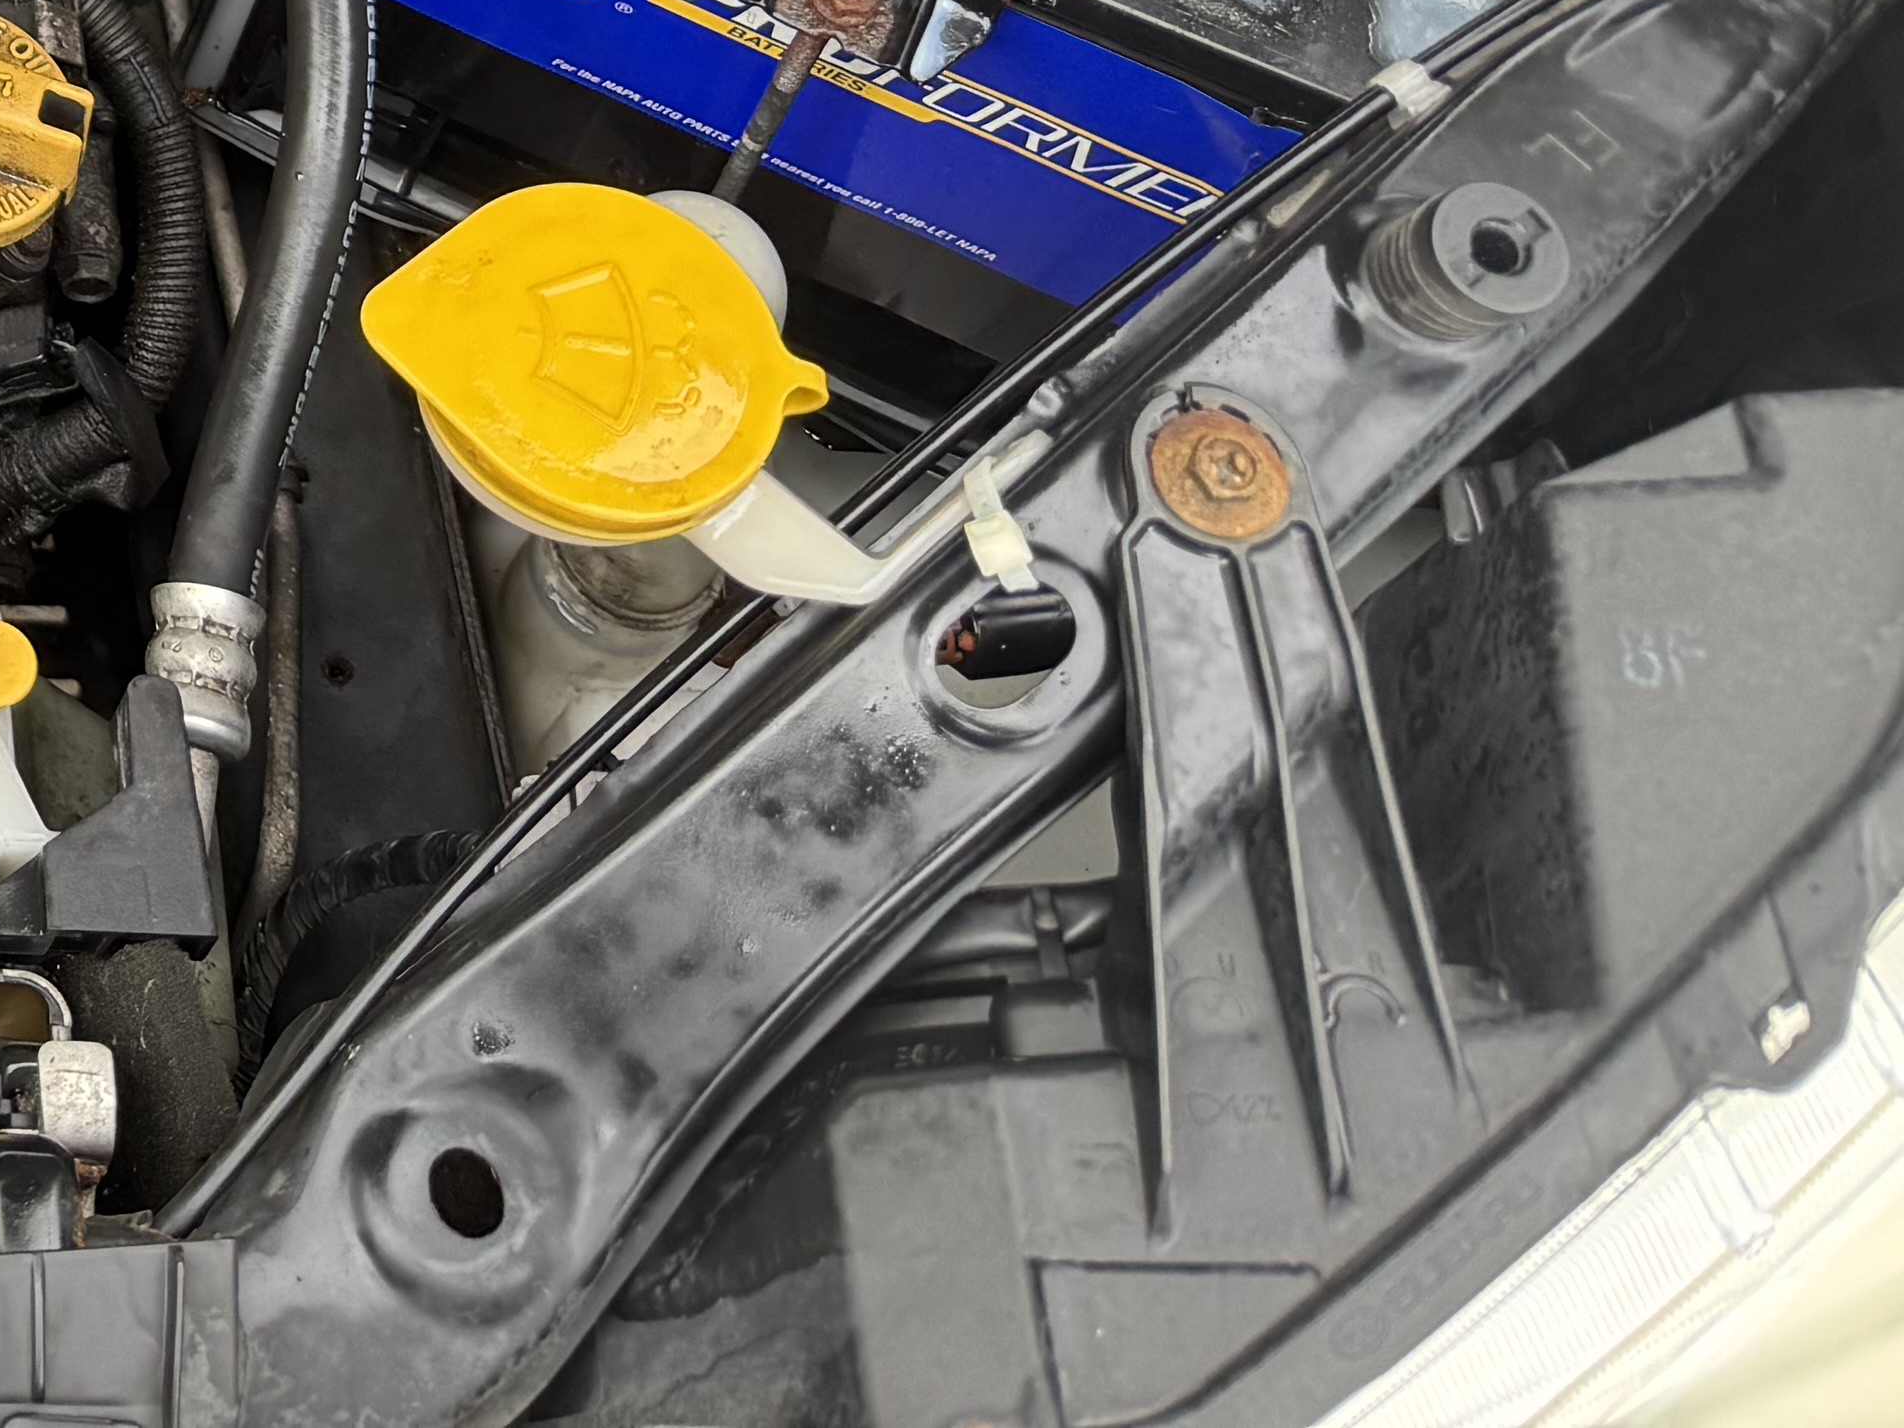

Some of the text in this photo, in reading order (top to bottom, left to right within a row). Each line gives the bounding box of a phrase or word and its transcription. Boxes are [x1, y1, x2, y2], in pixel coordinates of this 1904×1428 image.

[551, 58, 729, 144] For the NAPA AUTO PARTS
[770, 154, 997, 261] nearest you call 1-800-LET NAPA
